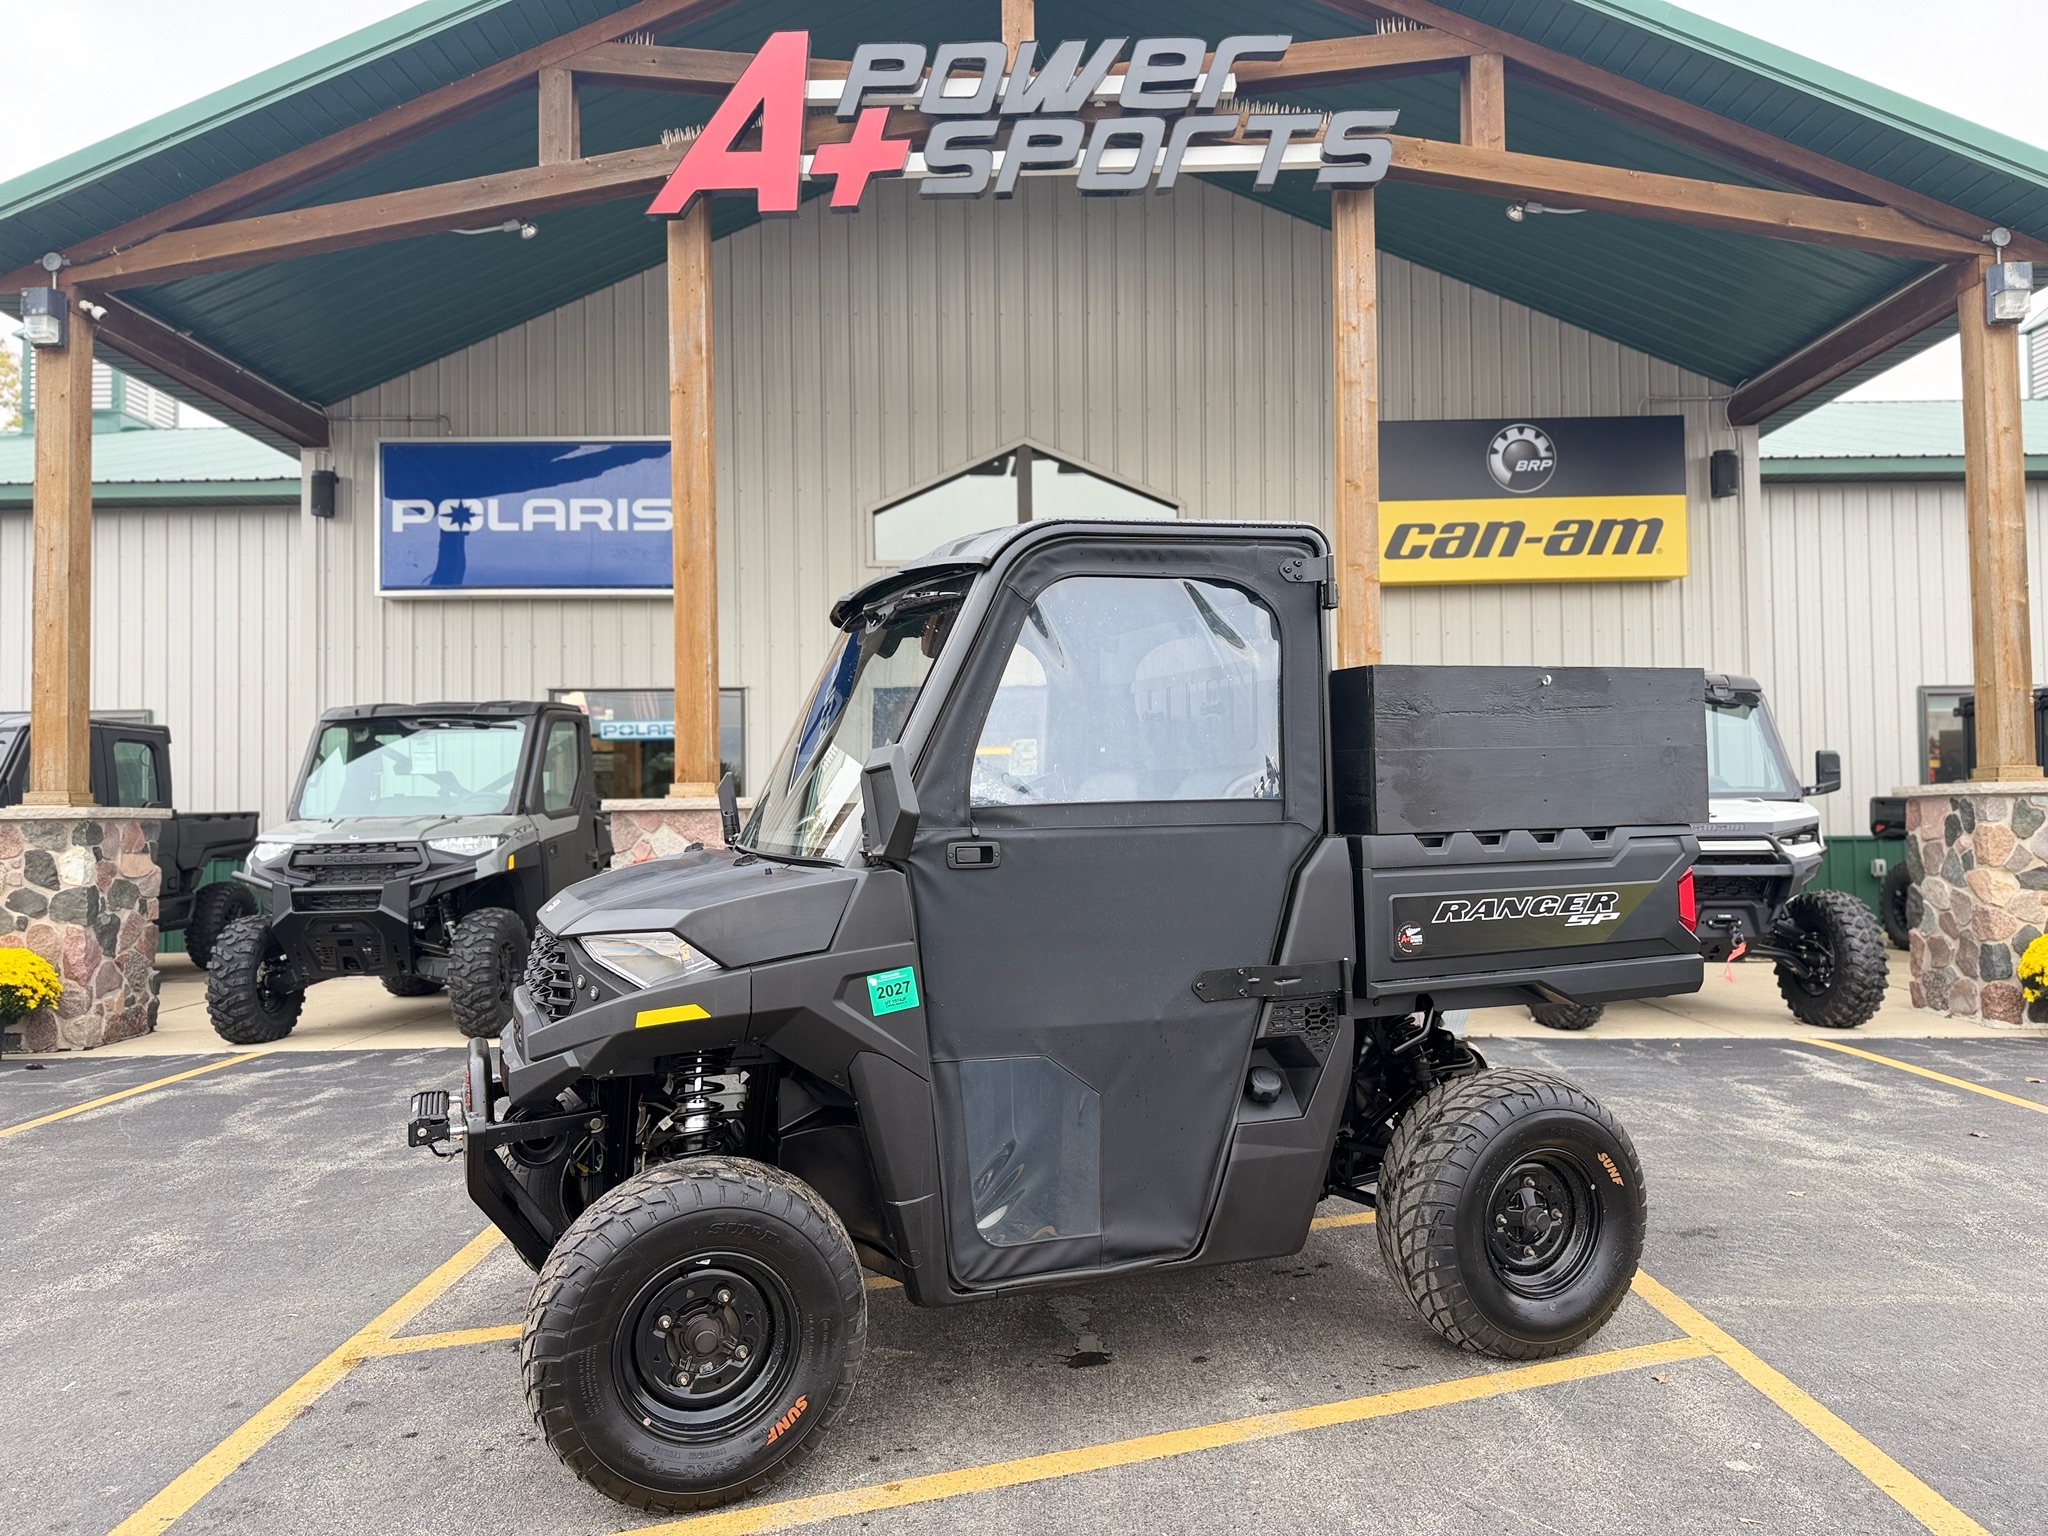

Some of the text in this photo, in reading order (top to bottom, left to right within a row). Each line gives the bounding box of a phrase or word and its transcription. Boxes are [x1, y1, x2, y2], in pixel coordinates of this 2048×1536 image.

[1515, 459, 1553, 472] BRP
[392, 498, 673, 532] POLARIS
[1384, 517, 1664, 560] can-am
[603, 724, 675, 736] POLAR
[325, 854, 382, 863] POLARIS
[1431, 891, 1619, 924] RANGER
[1563, 912, 1621, 927] SP
[876, 980, 911, 1000] 2027
[1597, 1152, 1625, 1187] SUNF
[766, 1394, 808, 1447] SUNF
